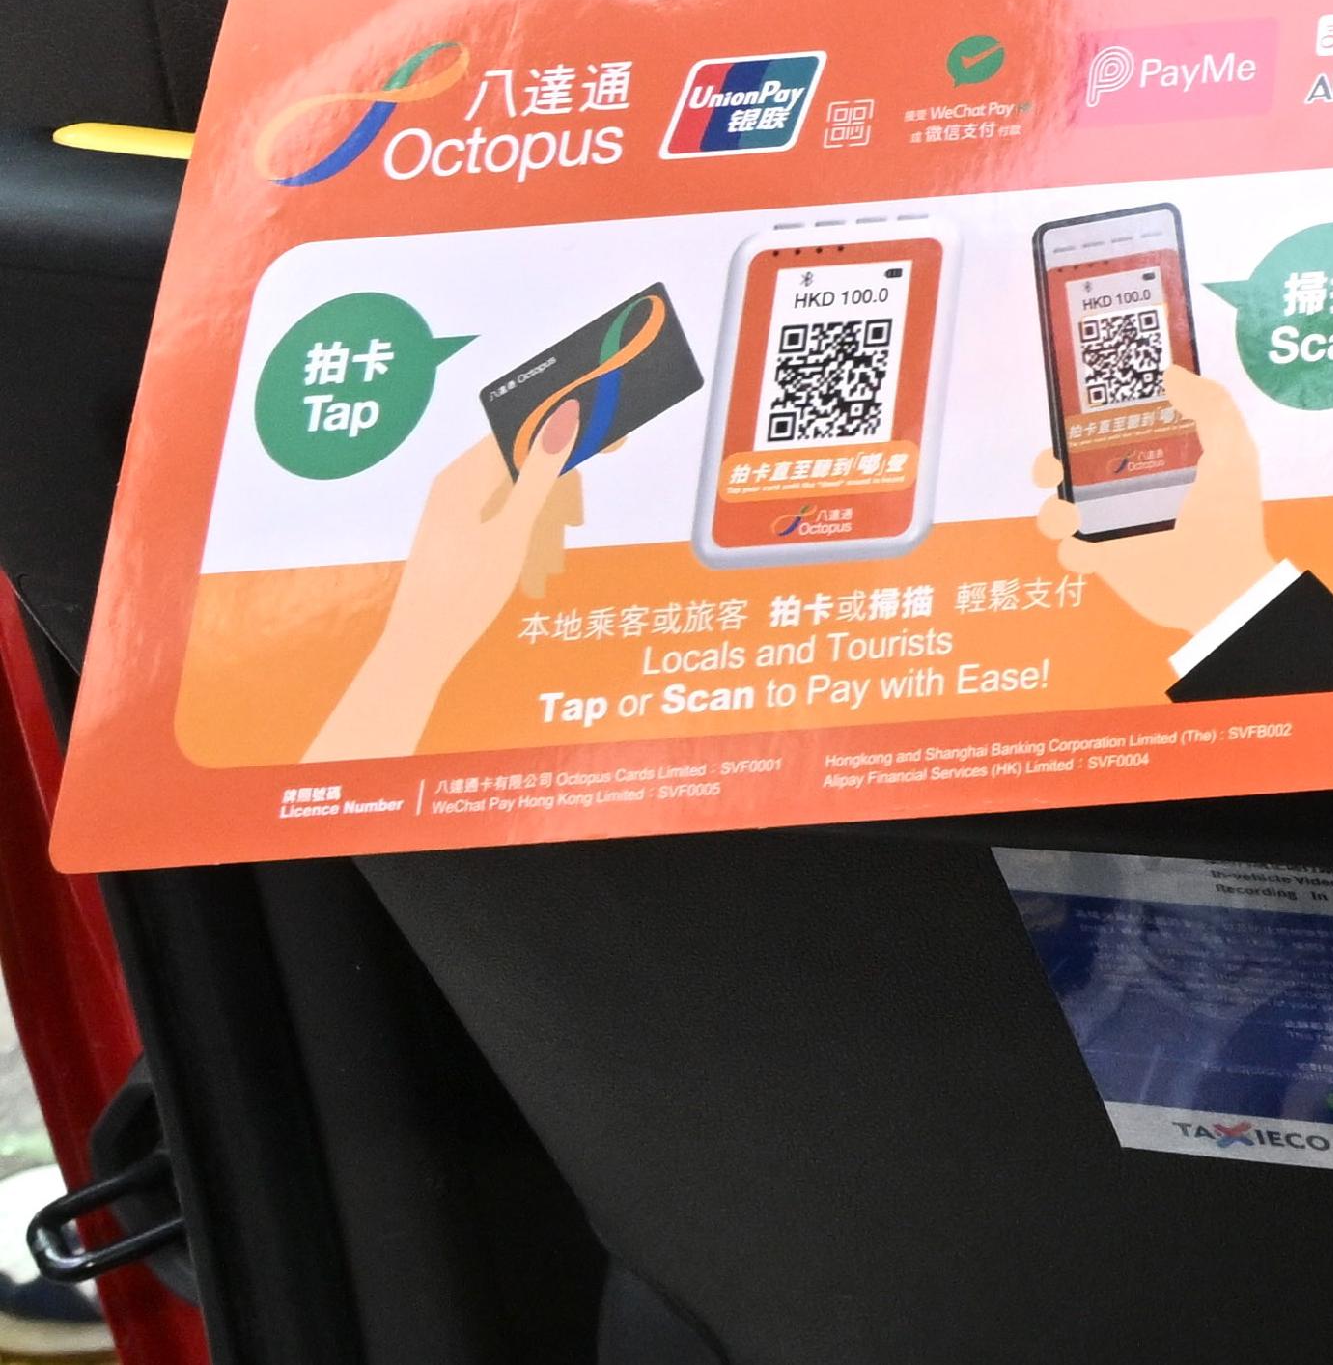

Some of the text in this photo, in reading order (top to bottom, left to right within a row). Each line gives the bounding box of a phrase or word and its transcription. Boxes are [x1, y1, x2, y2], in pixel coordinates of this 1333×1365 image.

[1139, 49, 1256, 90] PayMe
[465, 60, 633, 121] 八達通
[688, 83, 804, 110] UnionPay
[727, 107, 789, 132] 银联
[931, 101, 1015, 120] WeChat Pay
[383, 124, 624, 182] Octopus
[794, 286, 889, 310] HKD 100.0
[1081, 288, 1151, 313] HKD 100.0
[304, 339, 395, 387] 拍卡
[303, 393, 380, 439] Tap
[799, 521, 853, 536] Octopus
[519, 574, 1087, 646] 本地乘客或旅客 拍卡或掃描 輕鬆支付
[643, 627, 953, 677] Locals and Tourists
[539, 658, 1050, 728] Tap or Scan to Pay with Ease!
[825, 751, 893, 769] Hongkong
[896, 749, 921, 764] and
[925, 745, 989, 762] Shanghai
[992, 741, 1046, 757] Banking
[1049, 732, 1126, 754] Corporation
[1130, 728, 1177, 747] Limited
[1181, 728, 1217, 746] (The)
[556, 771, 612, 787] Octopus
[614, 767, 655, 784] Cards
[658, 763, 707, 780] Limited
[720, 757, 782, 776] SVF0001
[823, 752, 1150, 789] Alipay Financial Services (HK) Limited SVF0004
[279, 798, 404, 820] Licence Number
[432, 795, 486, 815] WeChat
[488, 795, 515, 813] Pay
[518, 792, 553, 811] Hong
[557, 792, 593, 808] Kong
[596, 788, 645, 804] Limited
